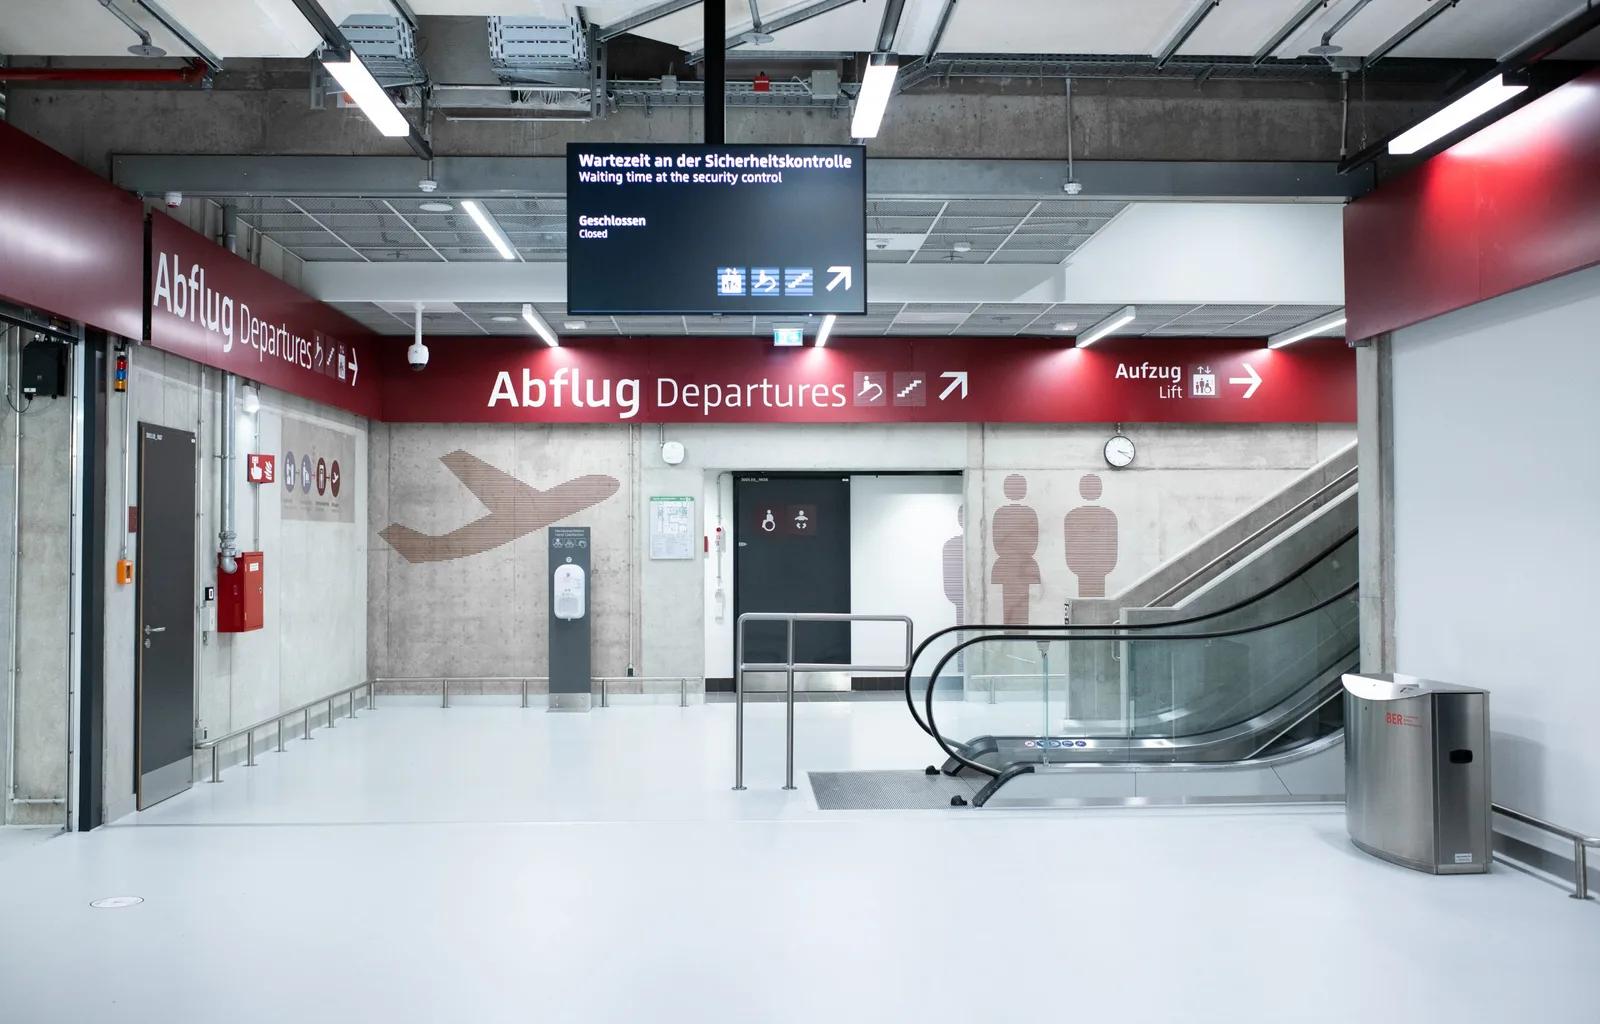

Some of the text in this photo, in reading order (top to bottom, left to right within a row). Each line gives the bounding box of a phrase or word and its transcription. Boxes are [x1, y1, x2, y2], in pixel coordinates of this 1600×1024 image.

[579, 153, 852, 169] Wartezeit an der Sicherheitskontrolle
[579, 171, 783, 186] Waiting time at the security control
[579, 215, 647, 227] Geschlossen
[579, 229, 608, 239] Closed
[153, 252, 312, 369] Abflug Departures
[1115, 362, 1181, 383] Aufzug
[488, 368, 846, 418] Abflug Departures
[1159, 385, 1182, 399] Lift
[1386, 712, 1403, 726] BER
